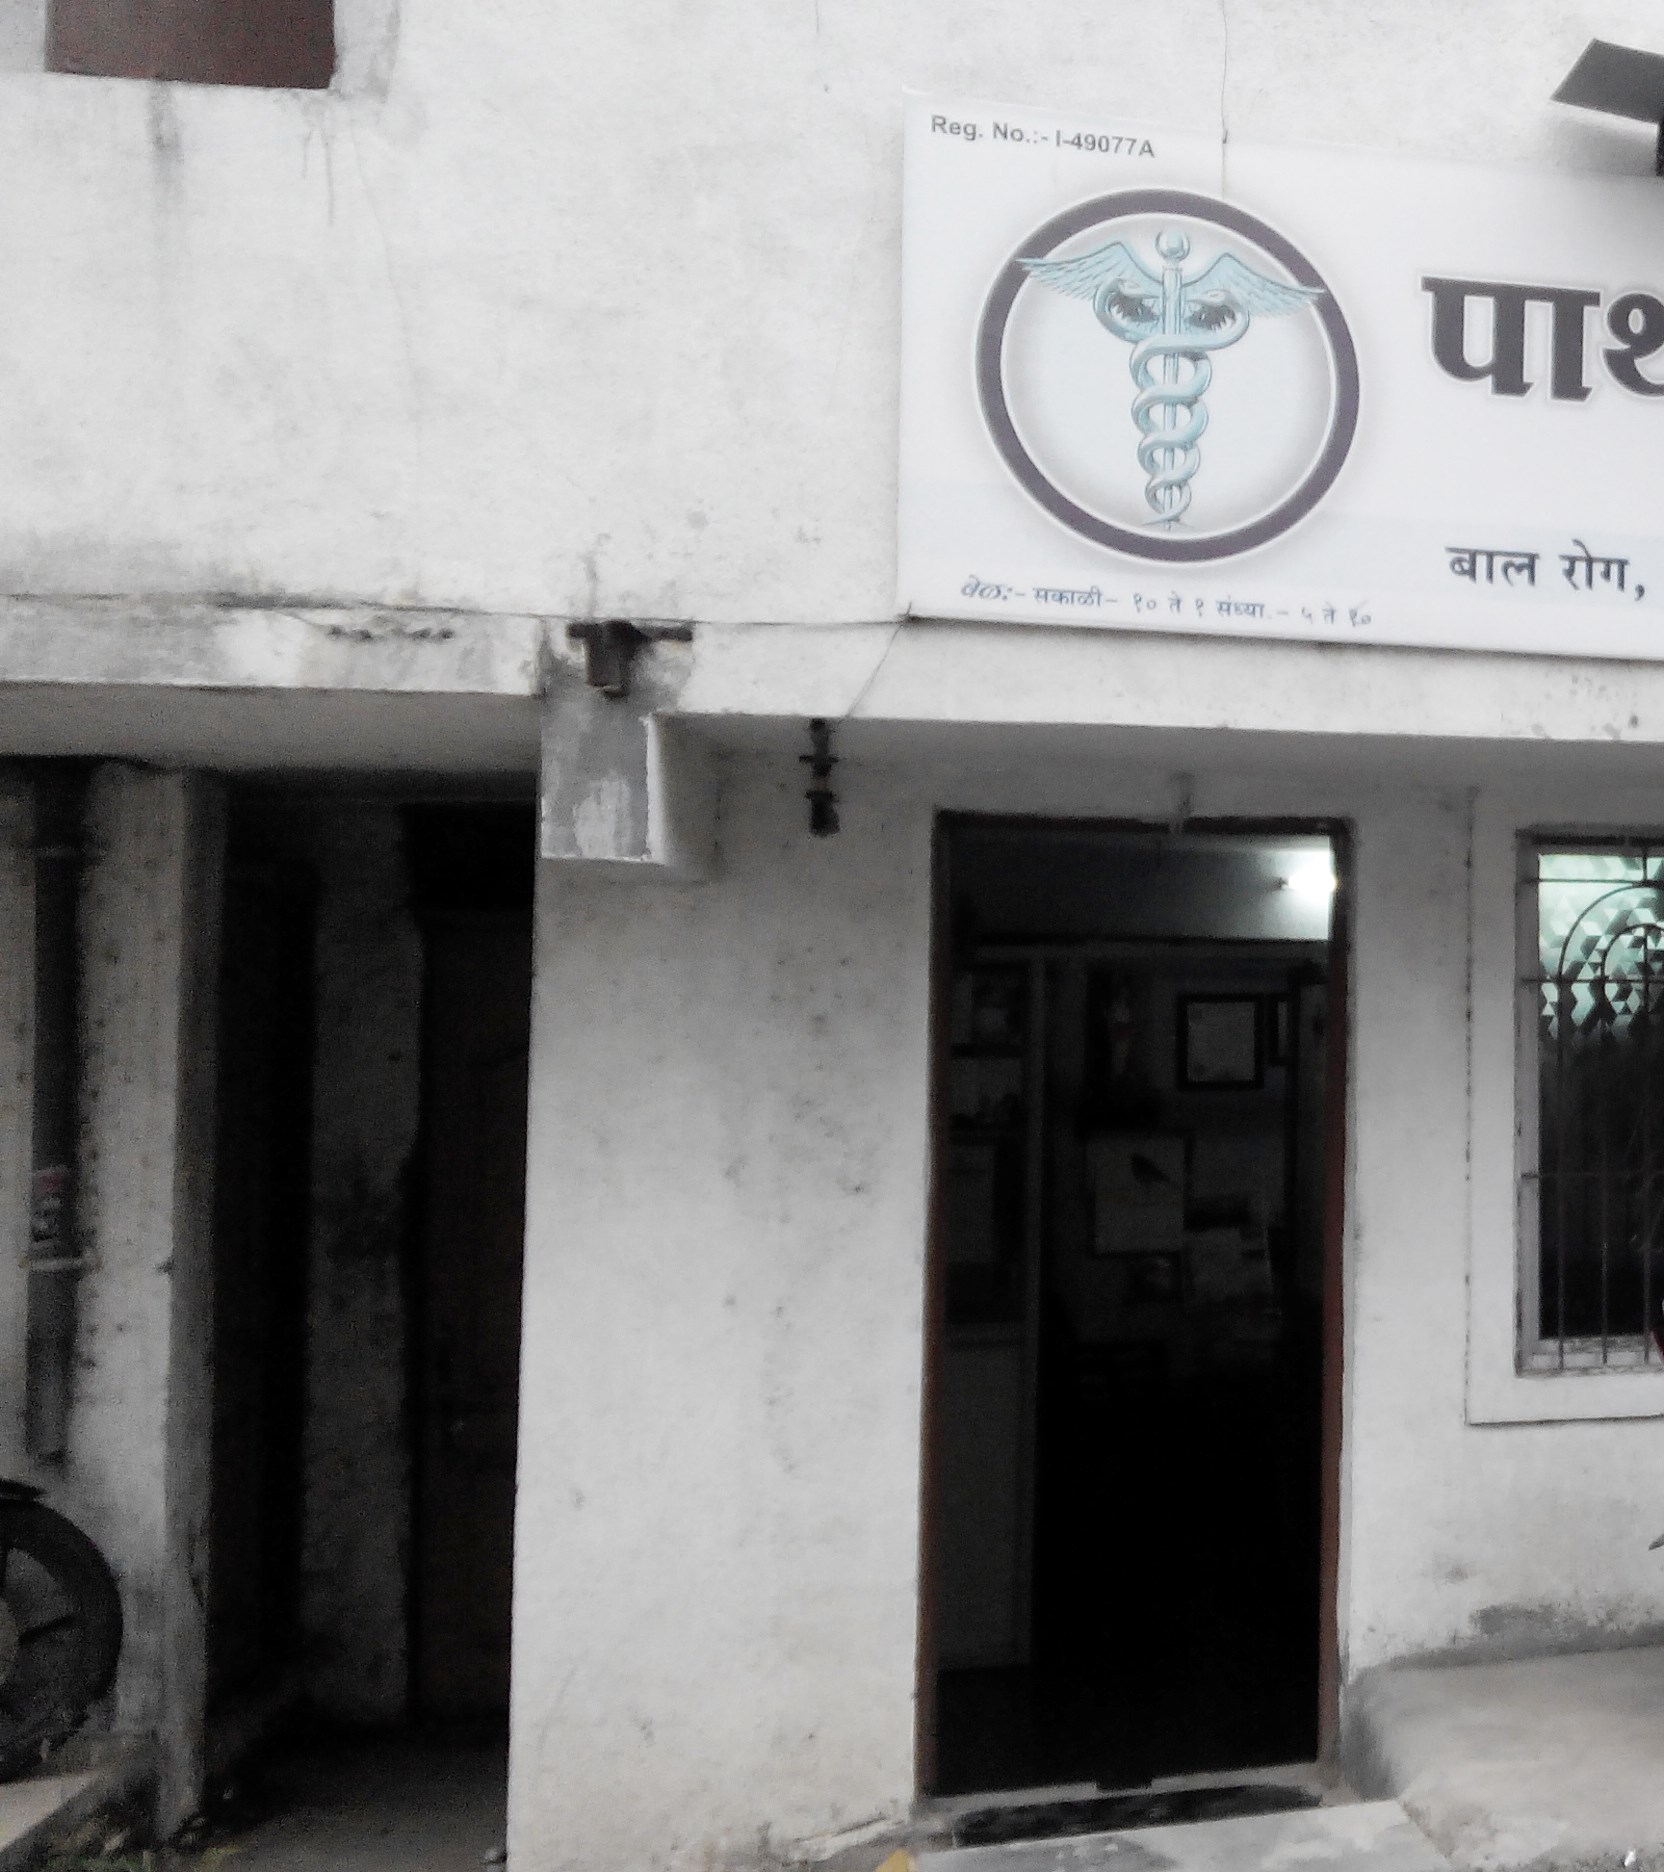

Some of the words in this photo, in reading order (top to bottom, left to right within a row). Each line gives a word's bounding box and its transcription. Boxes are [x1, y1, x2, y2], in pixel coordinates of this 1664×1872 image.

[932, 115, 983, 141] Reg.
[1056, 130, 1155, 158] I-49077A
[1446, 548, 1540, 586] बाल
[1559, 539, 1645, 601] रोग,
